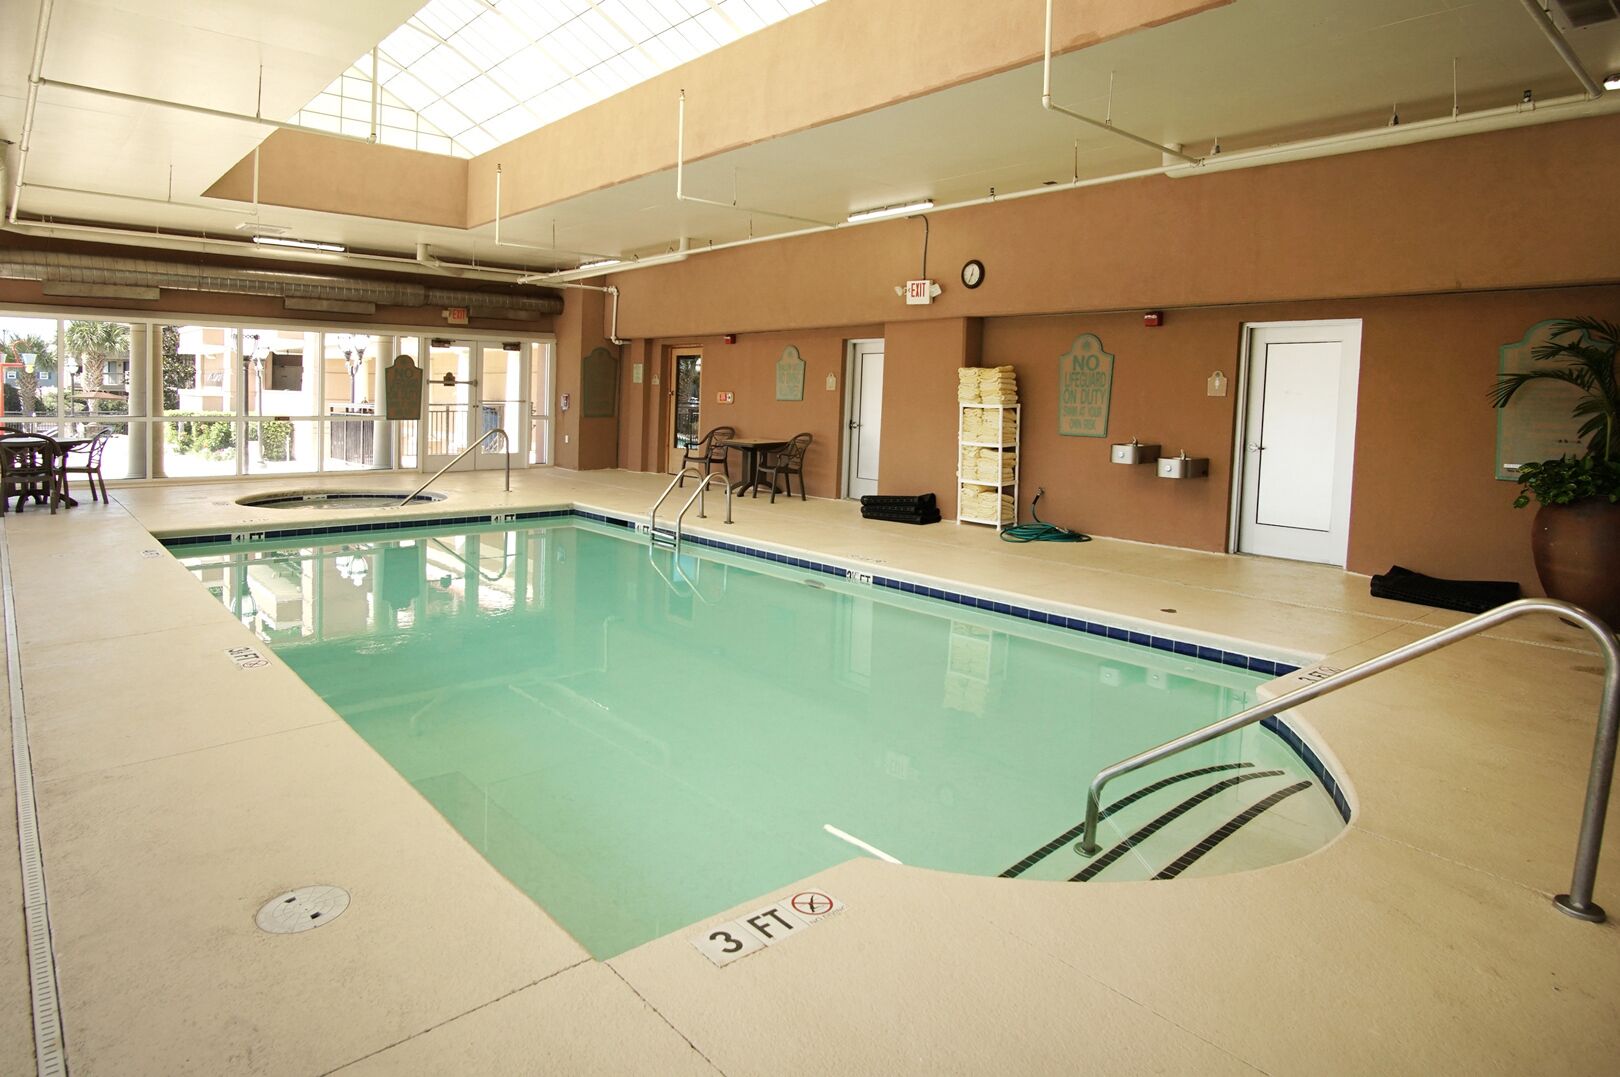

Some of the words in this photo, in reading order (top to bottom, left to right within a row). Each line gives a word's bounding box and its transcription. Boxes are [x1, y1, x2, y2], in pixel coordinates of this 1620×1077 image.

[911, 282, 926, 298] EXIT
[1072, 354, 1100, 371] NO
[1064, 371, 1106, 388] LIFEGUARD
[1063, 388, 1077, 404] ON
[1080, 388, 1106, 405] DUTY
[709, 931, 743, 953] 3
[746, 908, 794, 939] FT
